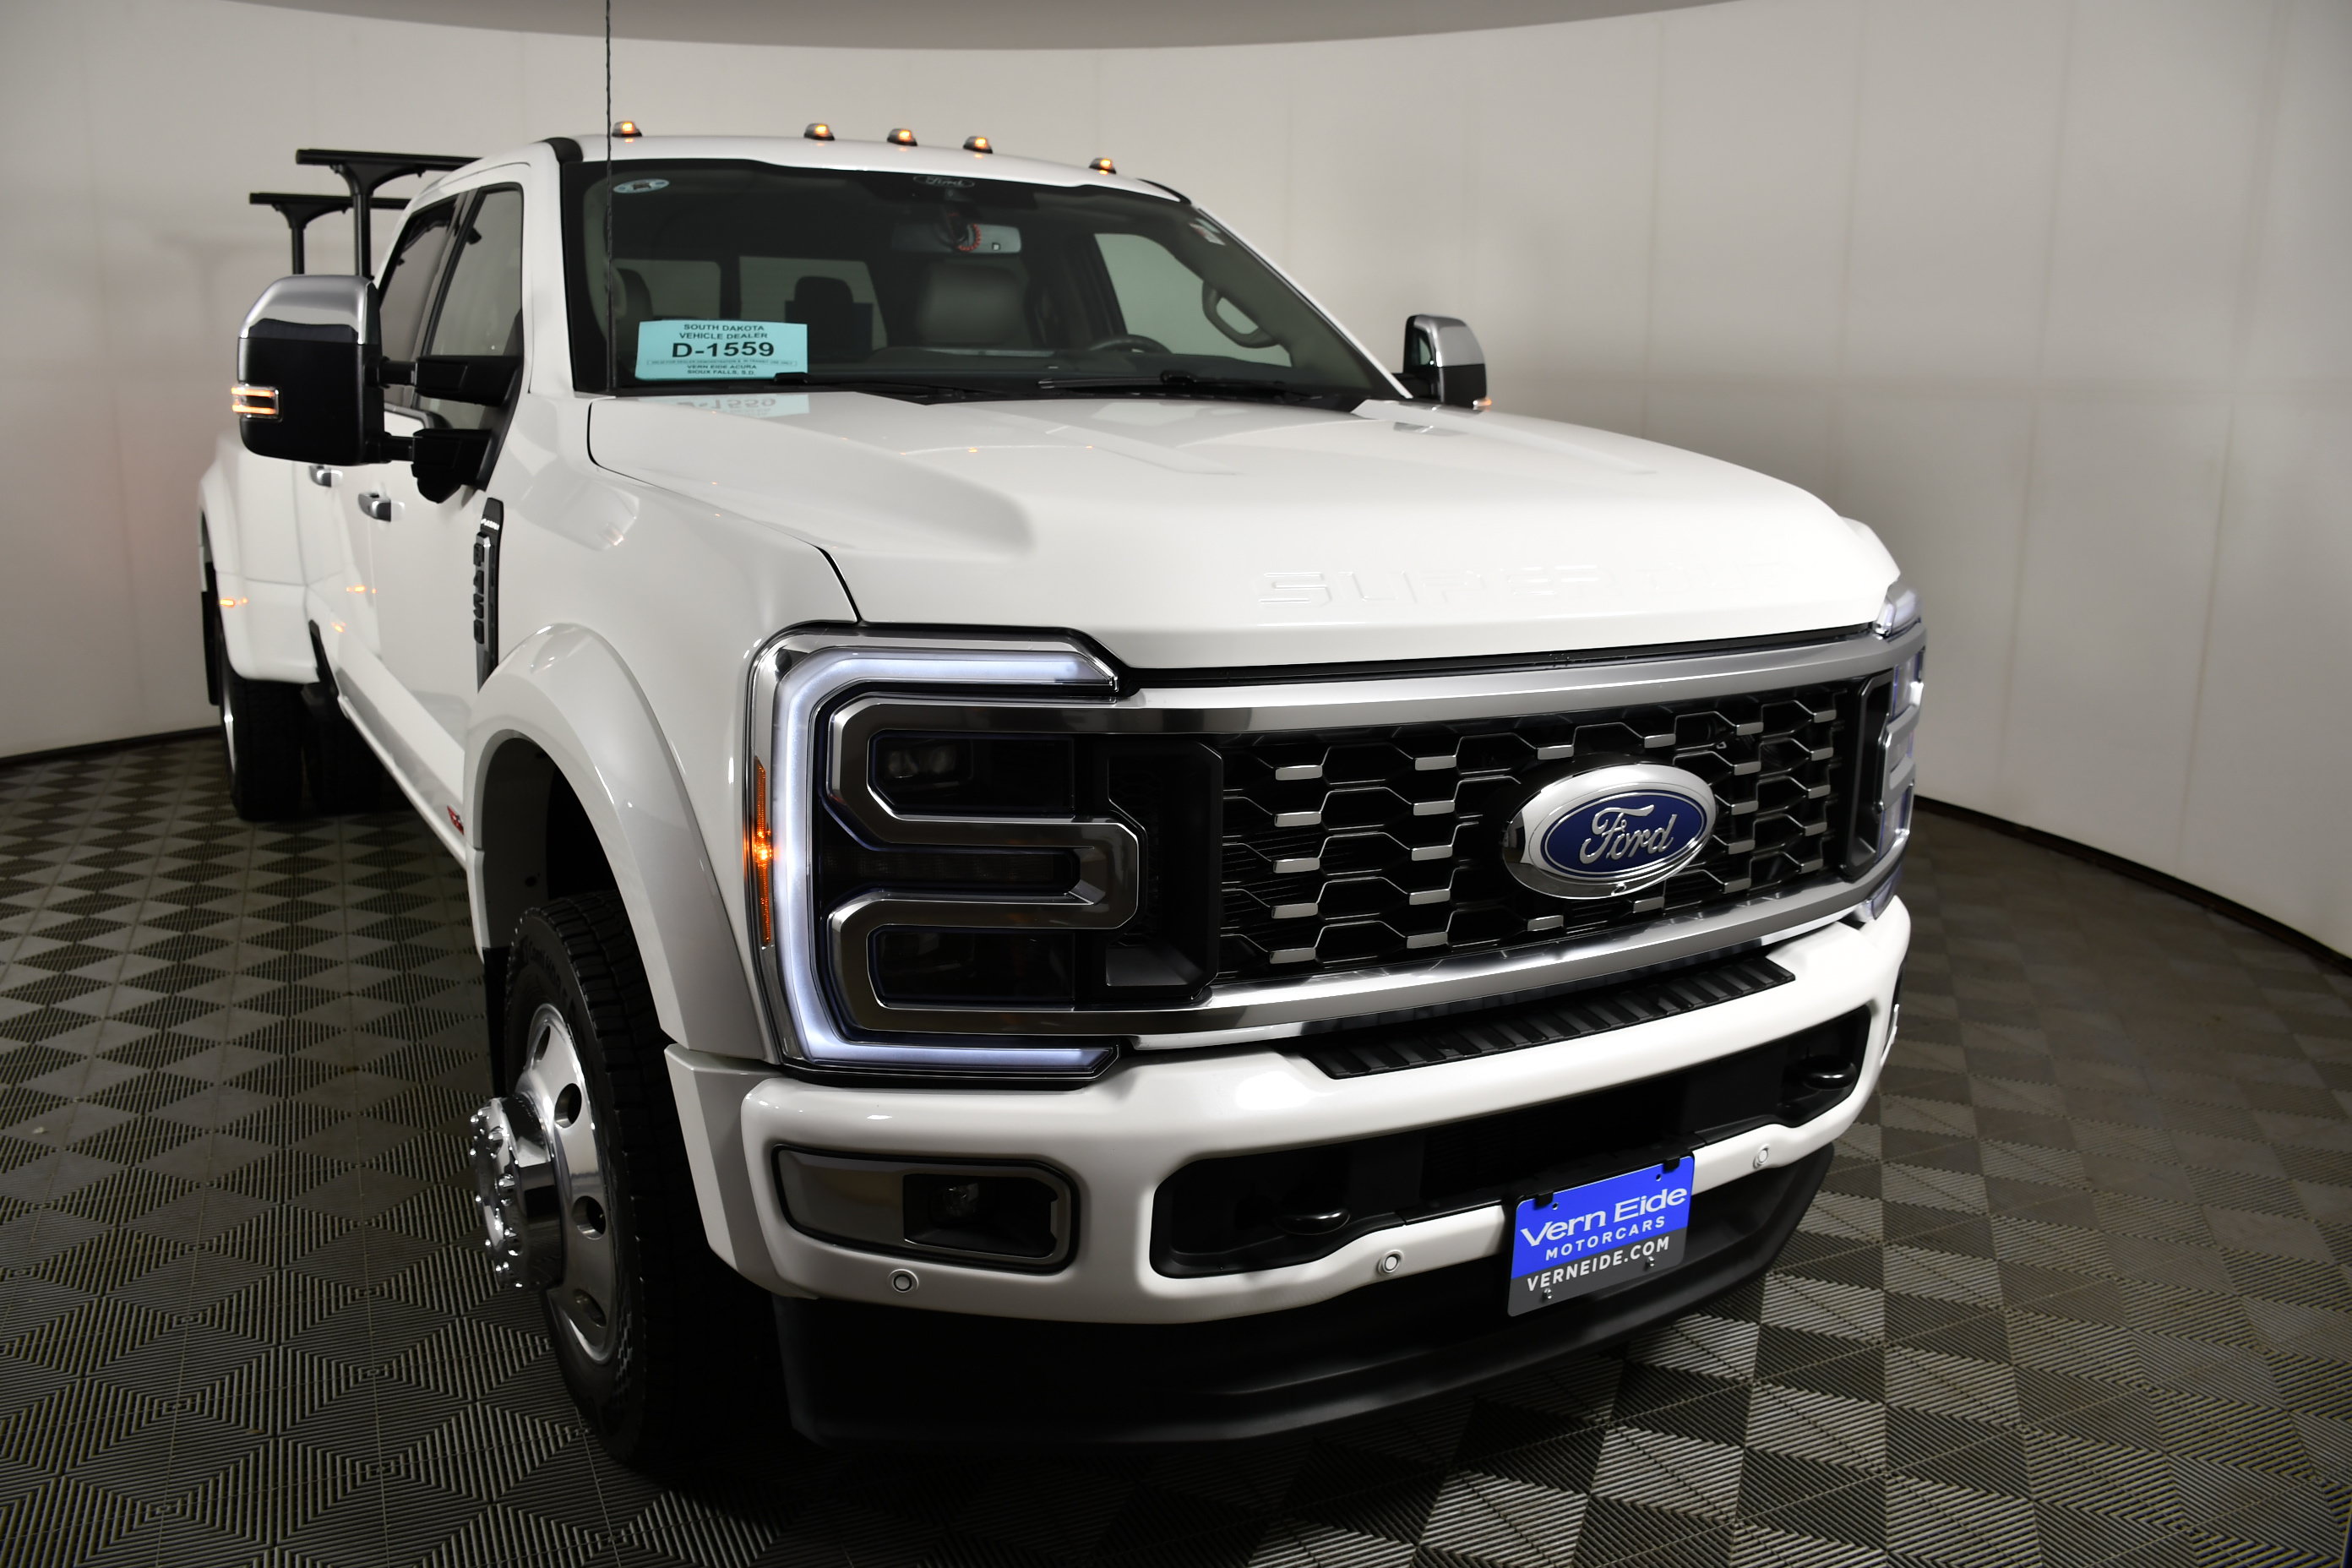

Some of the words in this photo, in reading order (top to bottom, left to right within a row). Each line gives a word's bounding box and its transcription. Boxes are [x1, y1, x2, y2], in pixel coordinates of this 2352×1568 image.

[672, 341, 774, 357] D-1559
[1579, 804, 1678, 864] Ford
[1521, 1209, 1606, 1247] Vern
[1614, 1187, 1688, 1222] Eide
[1545, 1216, 1665, 1260] MOTORCARS
[1527, 1236, 1669, 1292] VERNEIDE.COM
